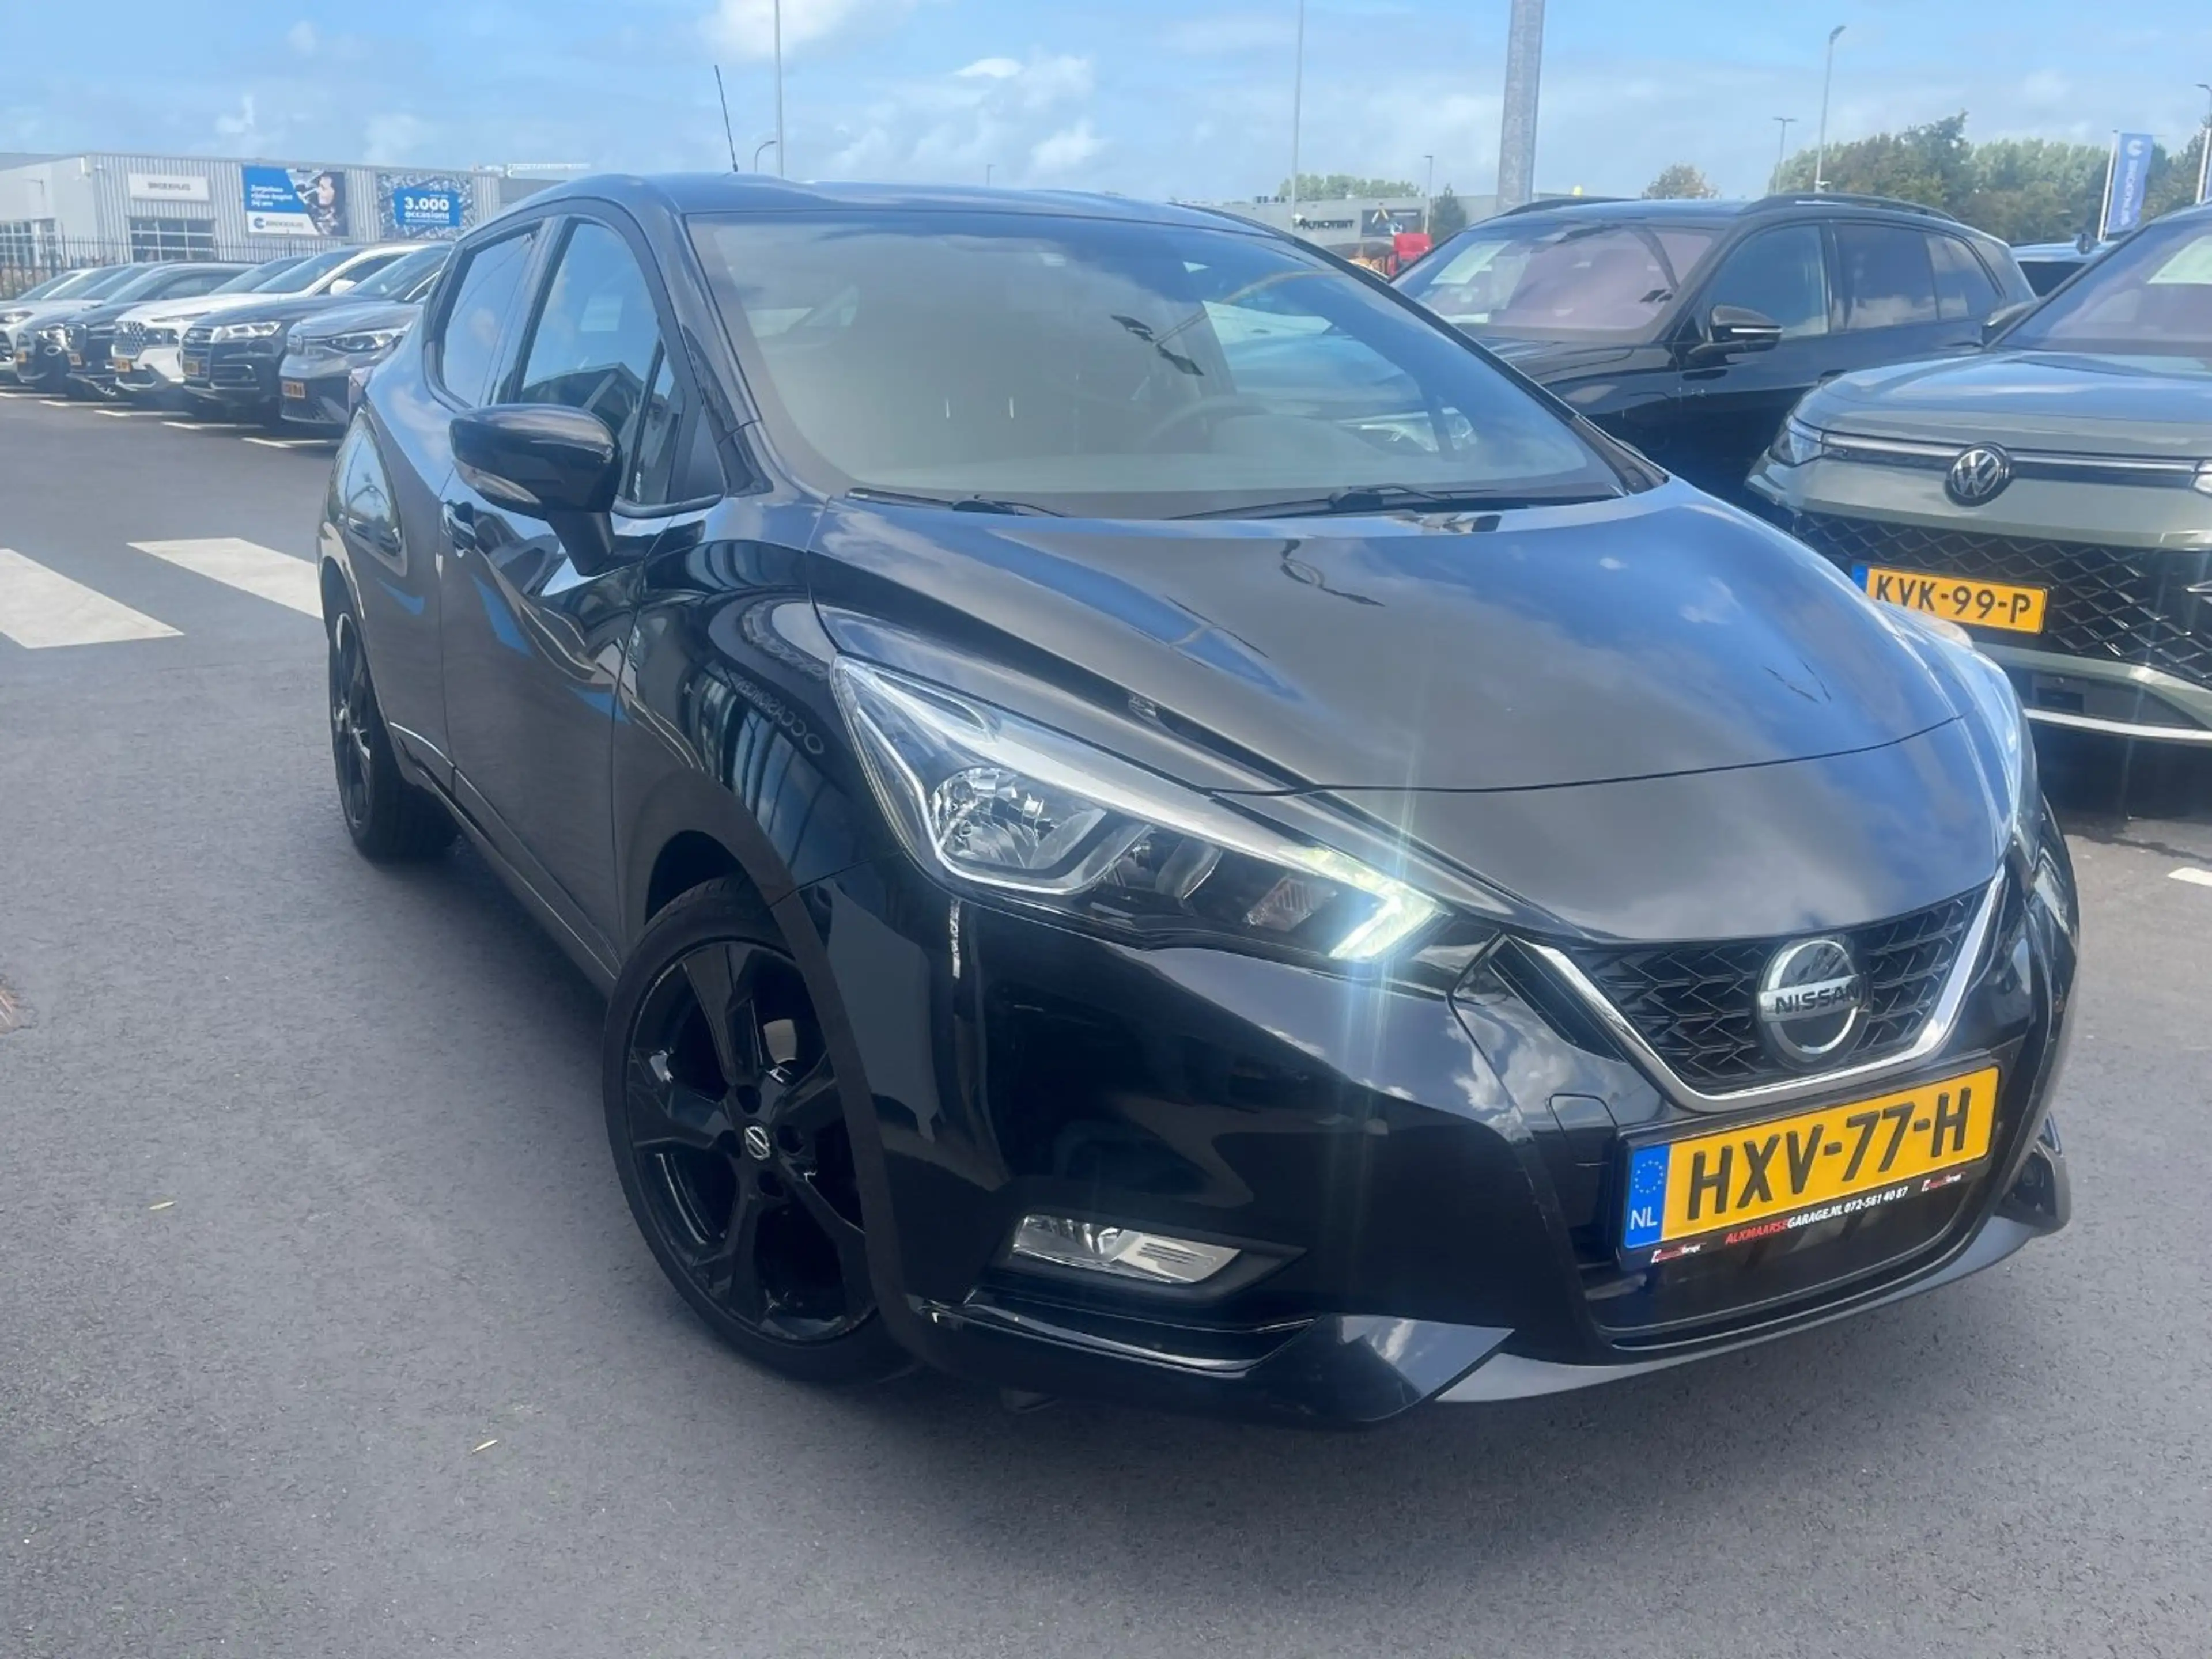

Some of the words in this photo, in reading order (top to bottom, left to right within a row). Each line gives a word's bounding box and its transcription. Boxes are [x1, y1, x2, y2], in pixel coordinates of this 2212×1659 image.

[404, 196, 449, 211] 3.000
[404, 210, 450, 219] occasions
[1876, 574, 2032, 624] KVK-99-P
[1775, 983, 1861, 1014] NISSAN
[1687, 1086, 1972, 1221] HXV-77-H
[1629, 1207, 1658, 1231] NL
